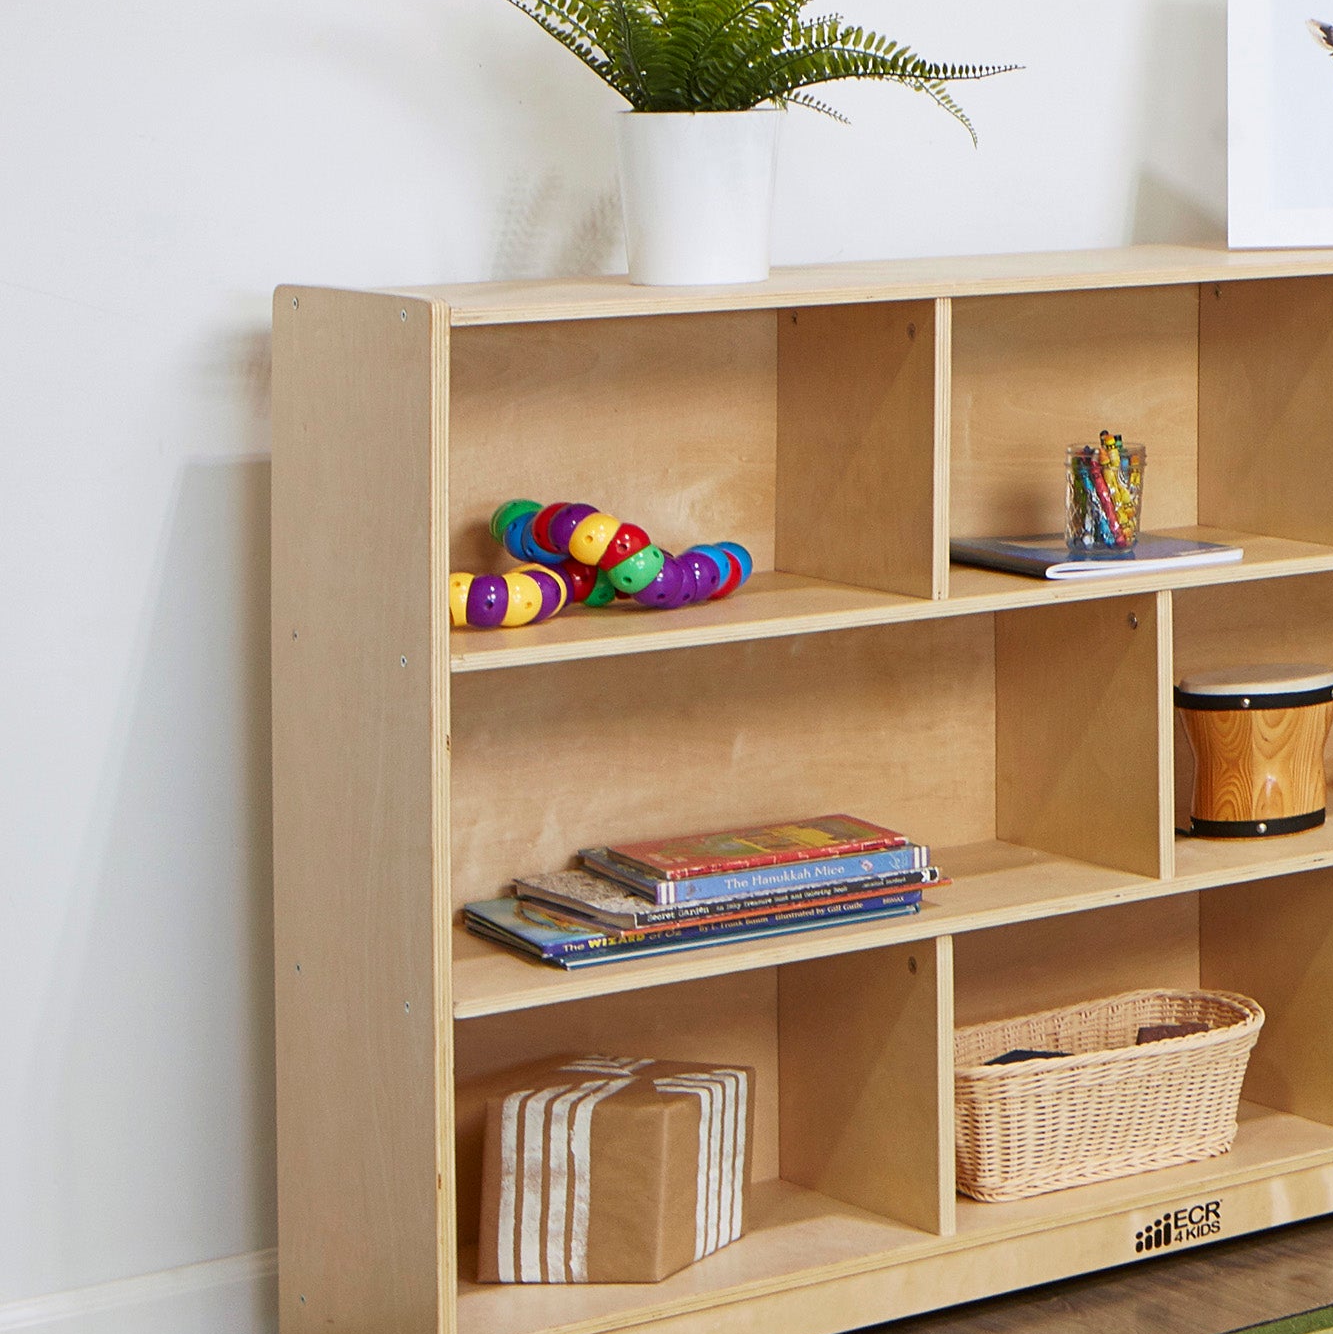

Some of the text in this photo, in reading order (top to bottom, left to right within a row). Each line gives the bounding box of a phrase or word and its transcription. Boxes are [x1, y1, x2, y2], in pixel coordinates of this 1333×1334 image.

[724, 865, 845, 890] The Hanukkah Mice
[563, 943, 585, 953] The
[588, 933, 646, 949] WIZARD
[1174, 1200, 1221, 1229] ECR
